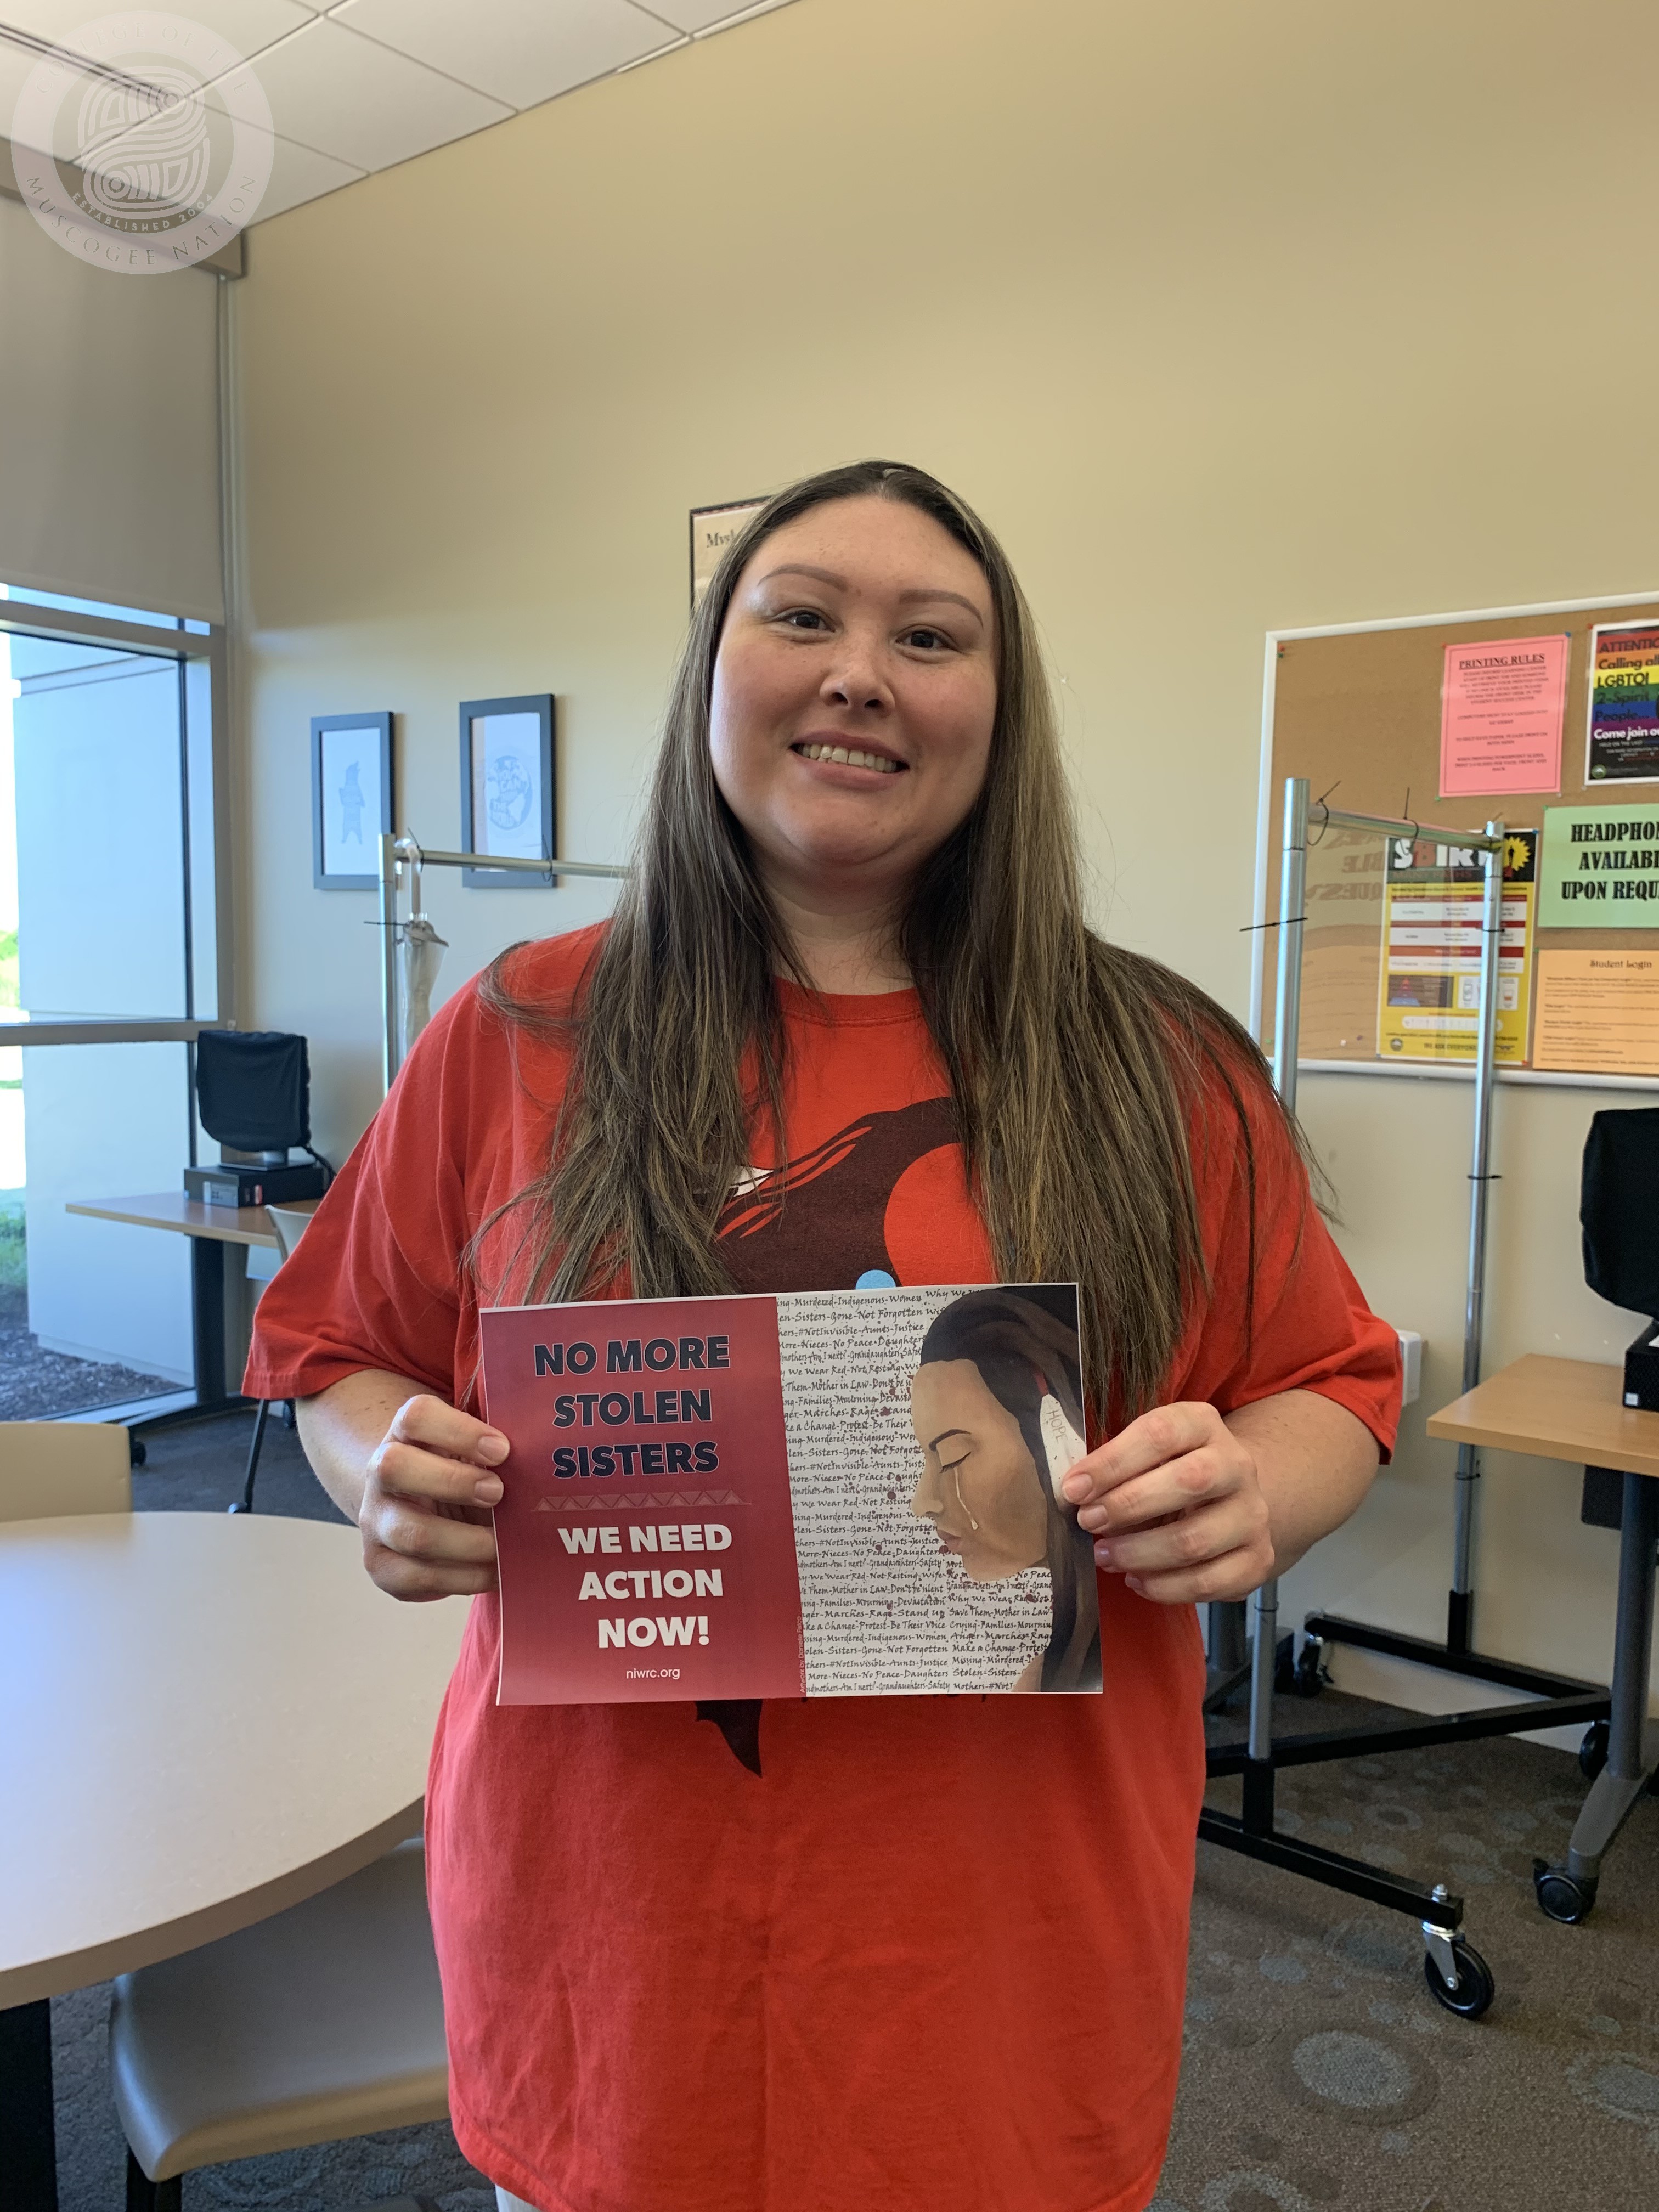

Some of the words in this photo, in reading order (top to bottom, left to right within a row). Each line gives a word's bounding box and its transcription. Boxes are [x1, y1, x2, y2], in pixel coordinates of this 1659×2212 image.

[1459, 657, 1508, 670] PRINTING
[1511, 653, 1545, 665] RULES
[1599, 657, 1643, 670] Calling
[1598, 672, 1649, 688] LGBTQI
[1594, 728, 1626, 740] Come
[1626, 726, 1648, 740] join
[1571, 821, 1659, 843] HEADPHO
[1562, 881, 1607, 900] UPON
[1590, 960, 1623, 968] Student
[1626, 960, 1652, 969] Login
[926, 1289, 949, 1301] Why
[878, 1307, 923, 1323] Forgotten
[533, 1341, 597, 1376] NO
[606, 1334, 730, 1373] MORE
[781, 1351, 821, 1363] mothers-Am
[805, 1367, 829, 1375] Wear
[831, 1365, 866, 1375] Red-Not
[840, 1381, 848, 1389] in
[552, 1388, 712, 1429] STOLEN
[885, 1418, 907, 1429] Their
[1046, 1410, 1068, 1443] HOPE
[787, 1432, 916, 1449] ing-Murdered-Indigenous-Wo
[890, 1446, 924, 1459] Forgott
[552, 1441, 719, 1480] SISTERS
[788, 1460, 926, 1471] hers-#NotInvisible-Aunts-Justi
[844, 1497, 878, 1507] Red-Not
[895, 1524, 937, 1537] Forgotten
[557, 1527, 621, 1554] WE
[630, 1523, 732, 1553] NEED
[798, 1549, 864, 1558] More-Nieces-No
[852, 1571, 885, 1580] Red-Not
[578, 1569, 723, 1600] ACTION
[808, 1584, 859, 1595] Them-Mother
[860, 1585, 868, 1593] in
[921, 1584, 944, 1593] silent
[948, 1594, 969, 1605] Why
[949, 1607, 968, 1616] Save
[970, 1606, 1020, 1617] Them-Mother
[1022, 1607, 1030, 1616] in
[598, 1616, 709, 1649] NOW!
[825, 1621, 901, 1635] Change-Protest-Be
[902, 1620, 923, 1629] Their
[906, 1645, 948, 1657] Forgotten
[952, 1644, 975, 1652] Make
[799, 1660, 805, 1668] by
[952, 1655, 1034, 1667] Missing-Murdered-I
[626, 1667, 680, 1680] niwrc.org
[808, 1671, 873, 1680] More-Nieces-No
[876, 1668, 948, 1681] Peace-Daughters
